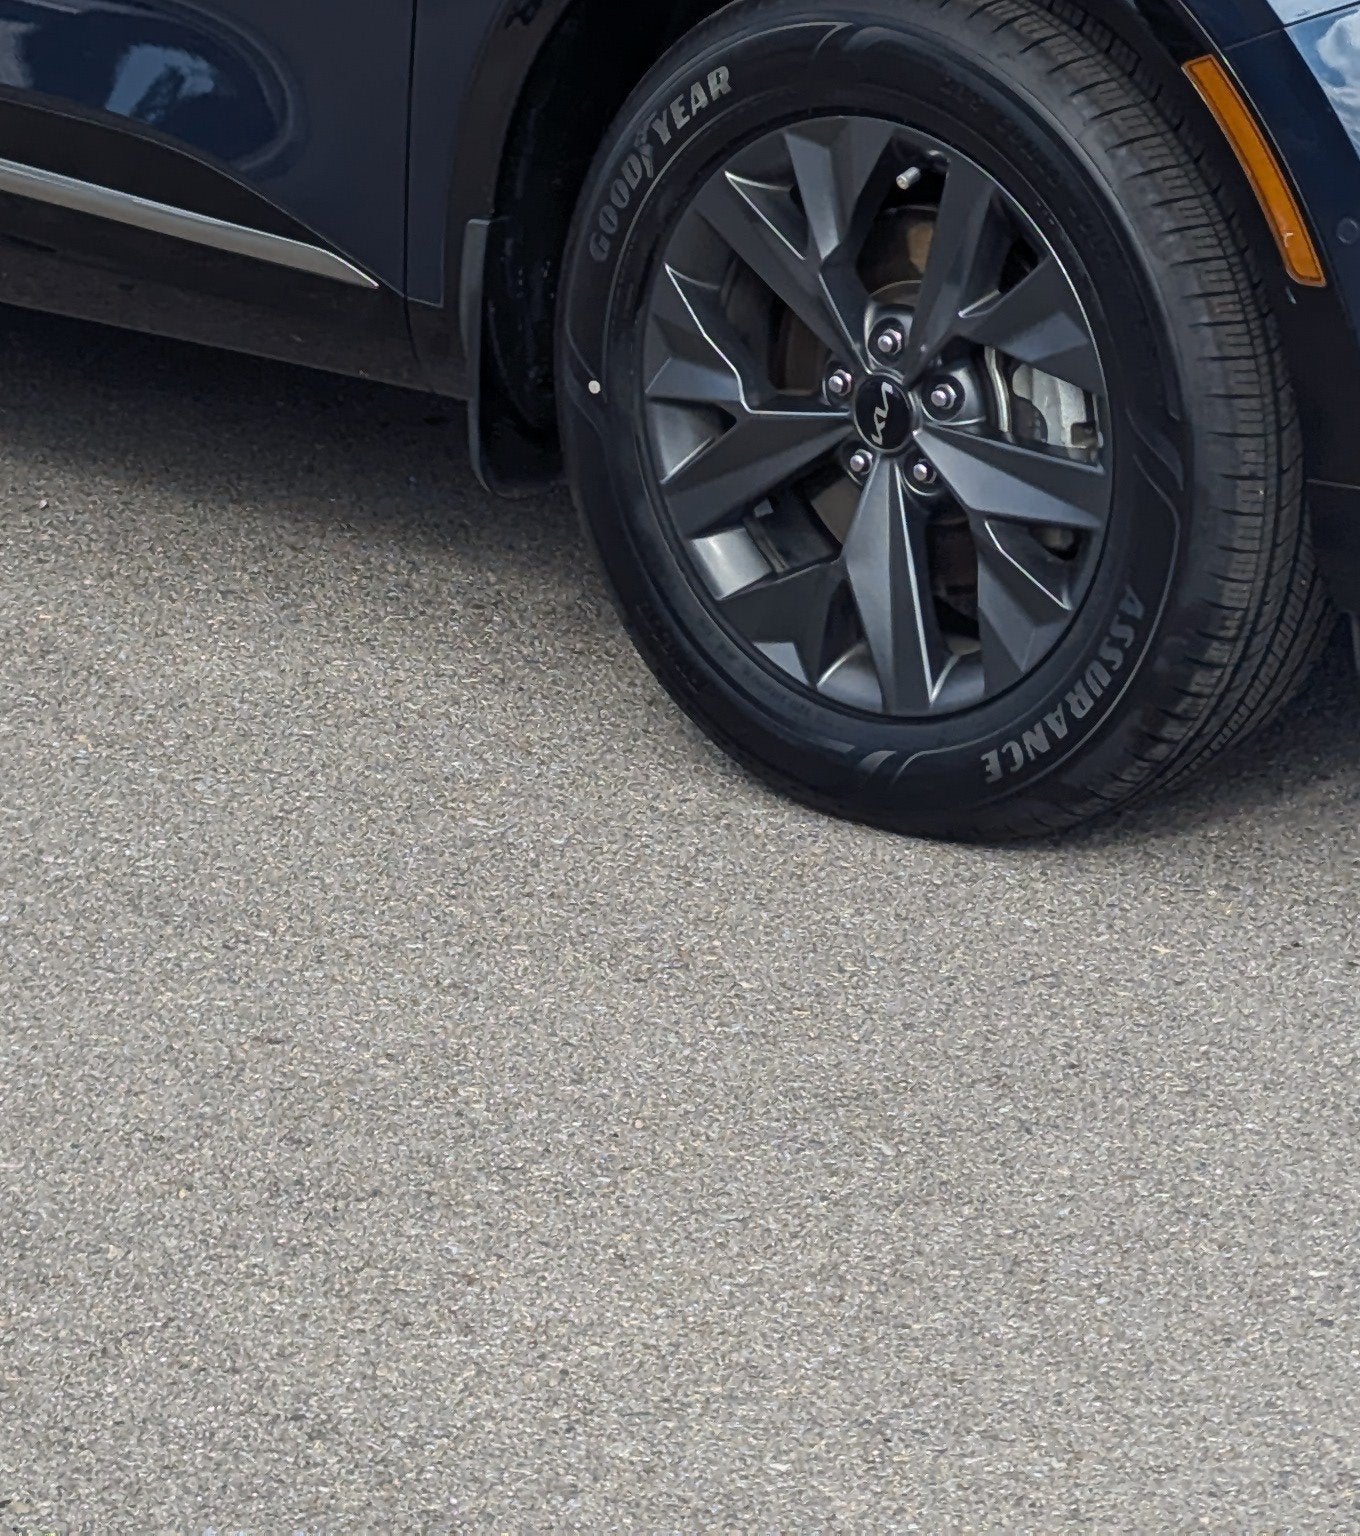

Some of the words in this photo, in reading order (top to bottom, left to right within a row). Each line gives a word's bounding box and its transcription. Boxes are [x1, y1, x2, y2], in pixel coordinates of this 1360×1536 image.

[589, 65, 732, 261] GOODYEAR
[871, 381, 897, 445] KIA
[980, 584, 1145, 783] ASSURANCE
